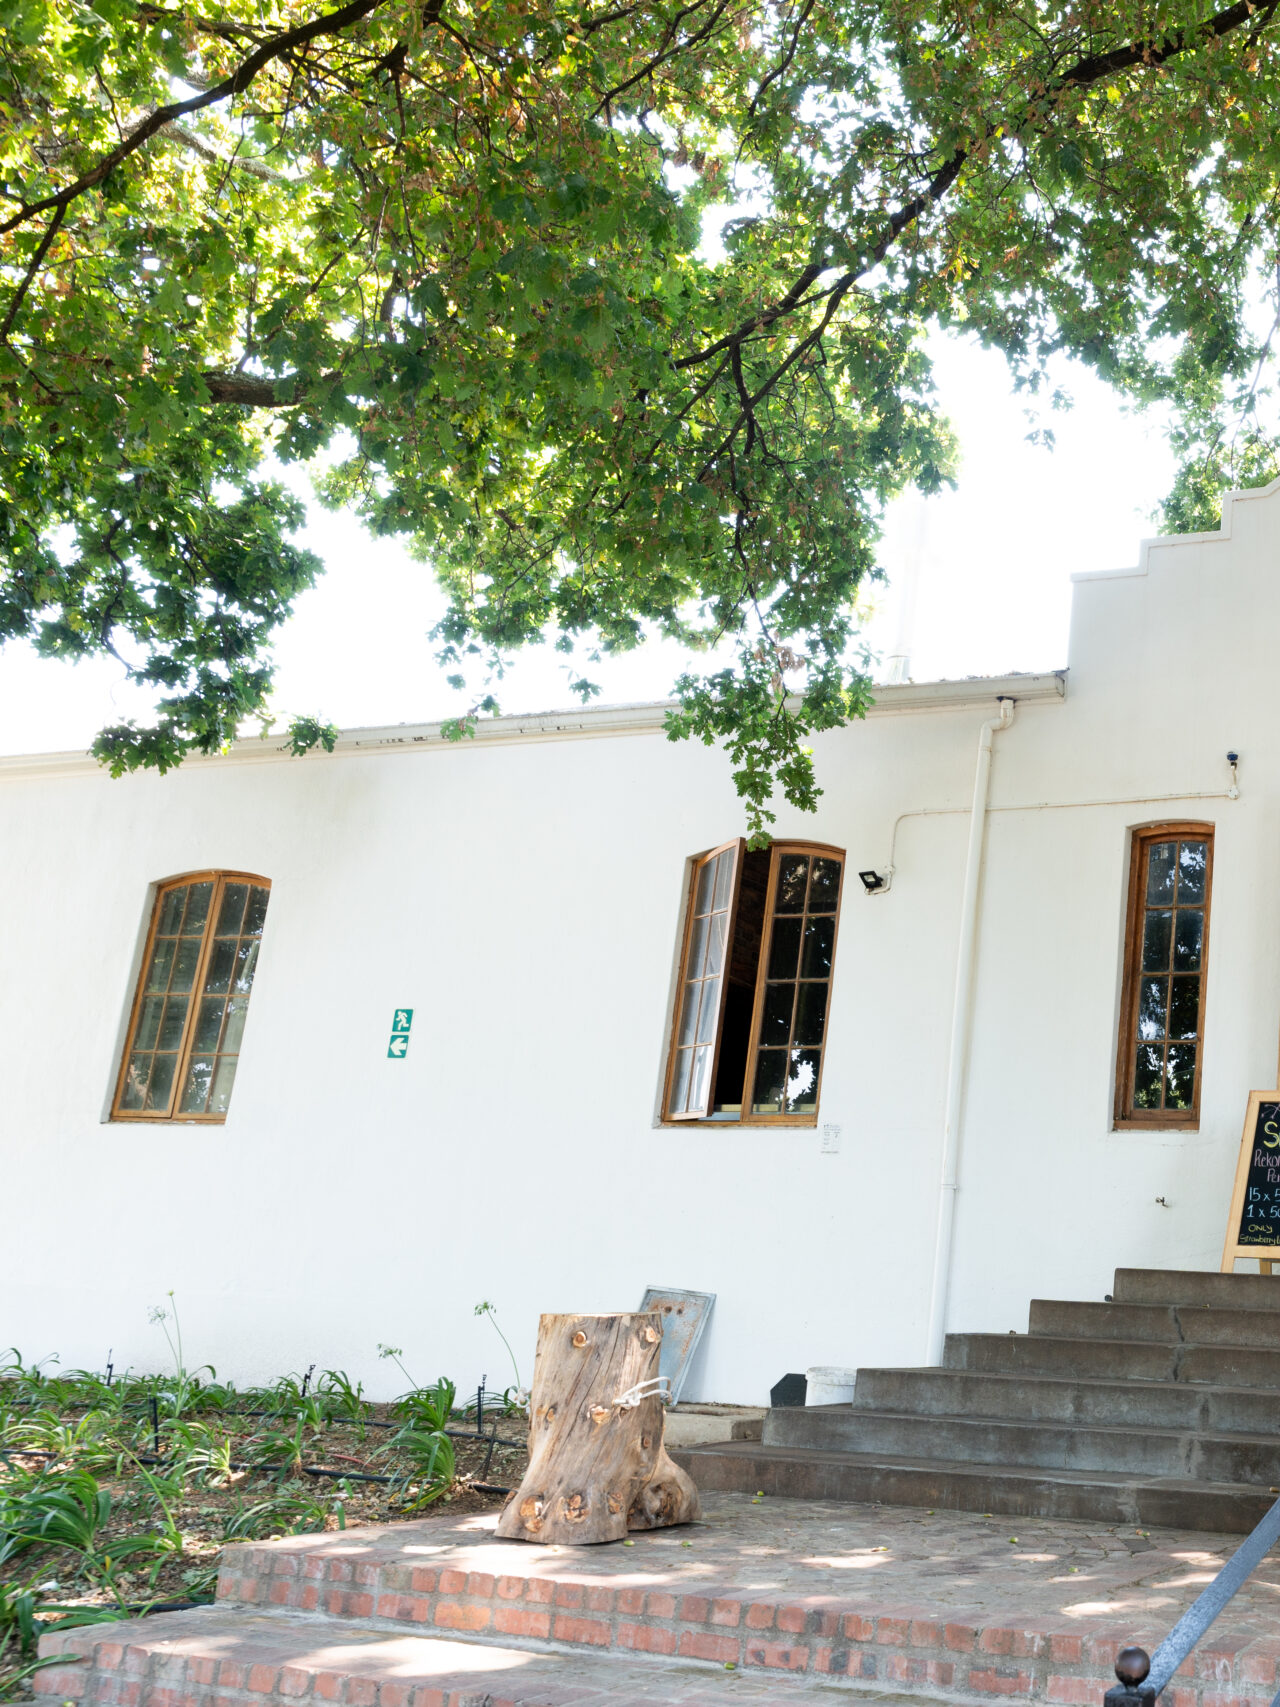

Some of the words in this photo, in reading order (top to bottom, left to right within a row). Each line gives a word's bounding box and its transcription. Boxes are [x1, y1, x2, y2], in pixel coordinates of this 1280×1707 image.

[1249, 1187, 1261, 1201] 15
[1263, 1193, 1270, 1201] x
[1247, 1204, 1254, 1218] 1
[1259, 1208, 1266, 1218] x
